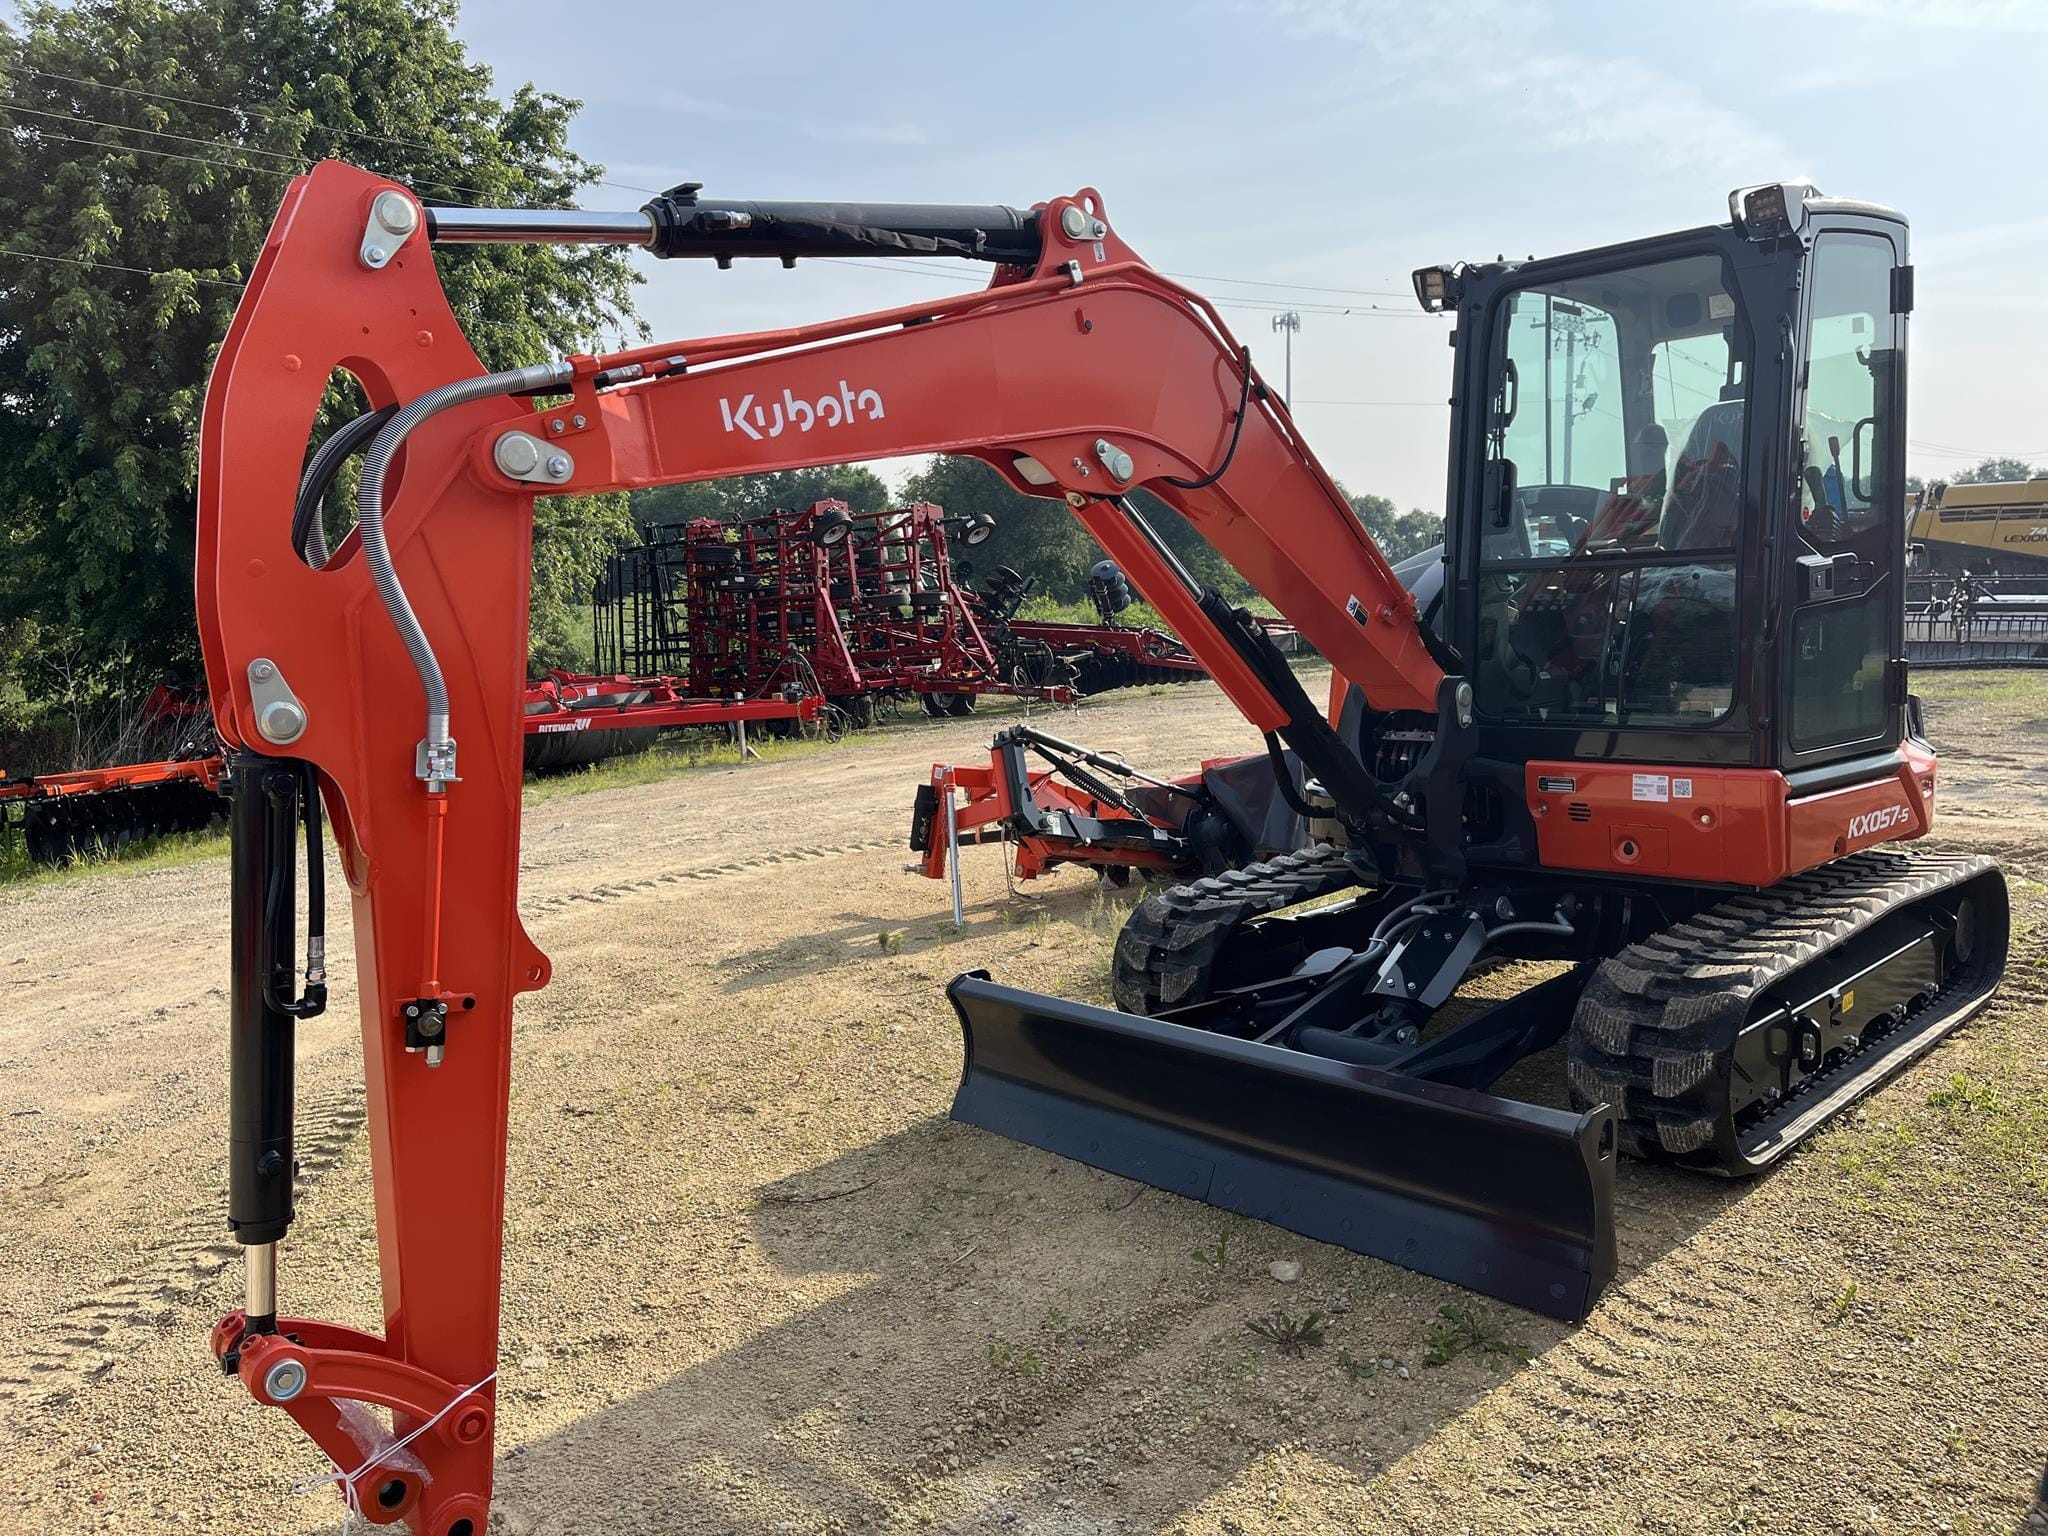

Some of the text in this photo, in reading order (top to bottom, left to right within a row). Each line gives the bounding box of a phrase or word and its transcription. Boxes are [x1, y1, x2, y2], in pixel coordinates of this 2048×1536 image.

[719, 380, 885, 440] Kubota
[2003, 534, 2048, 543] LEXION
[538, 722, 577, 733] RITEWAY
[1847, 804, 1909, 839] KX057-5
